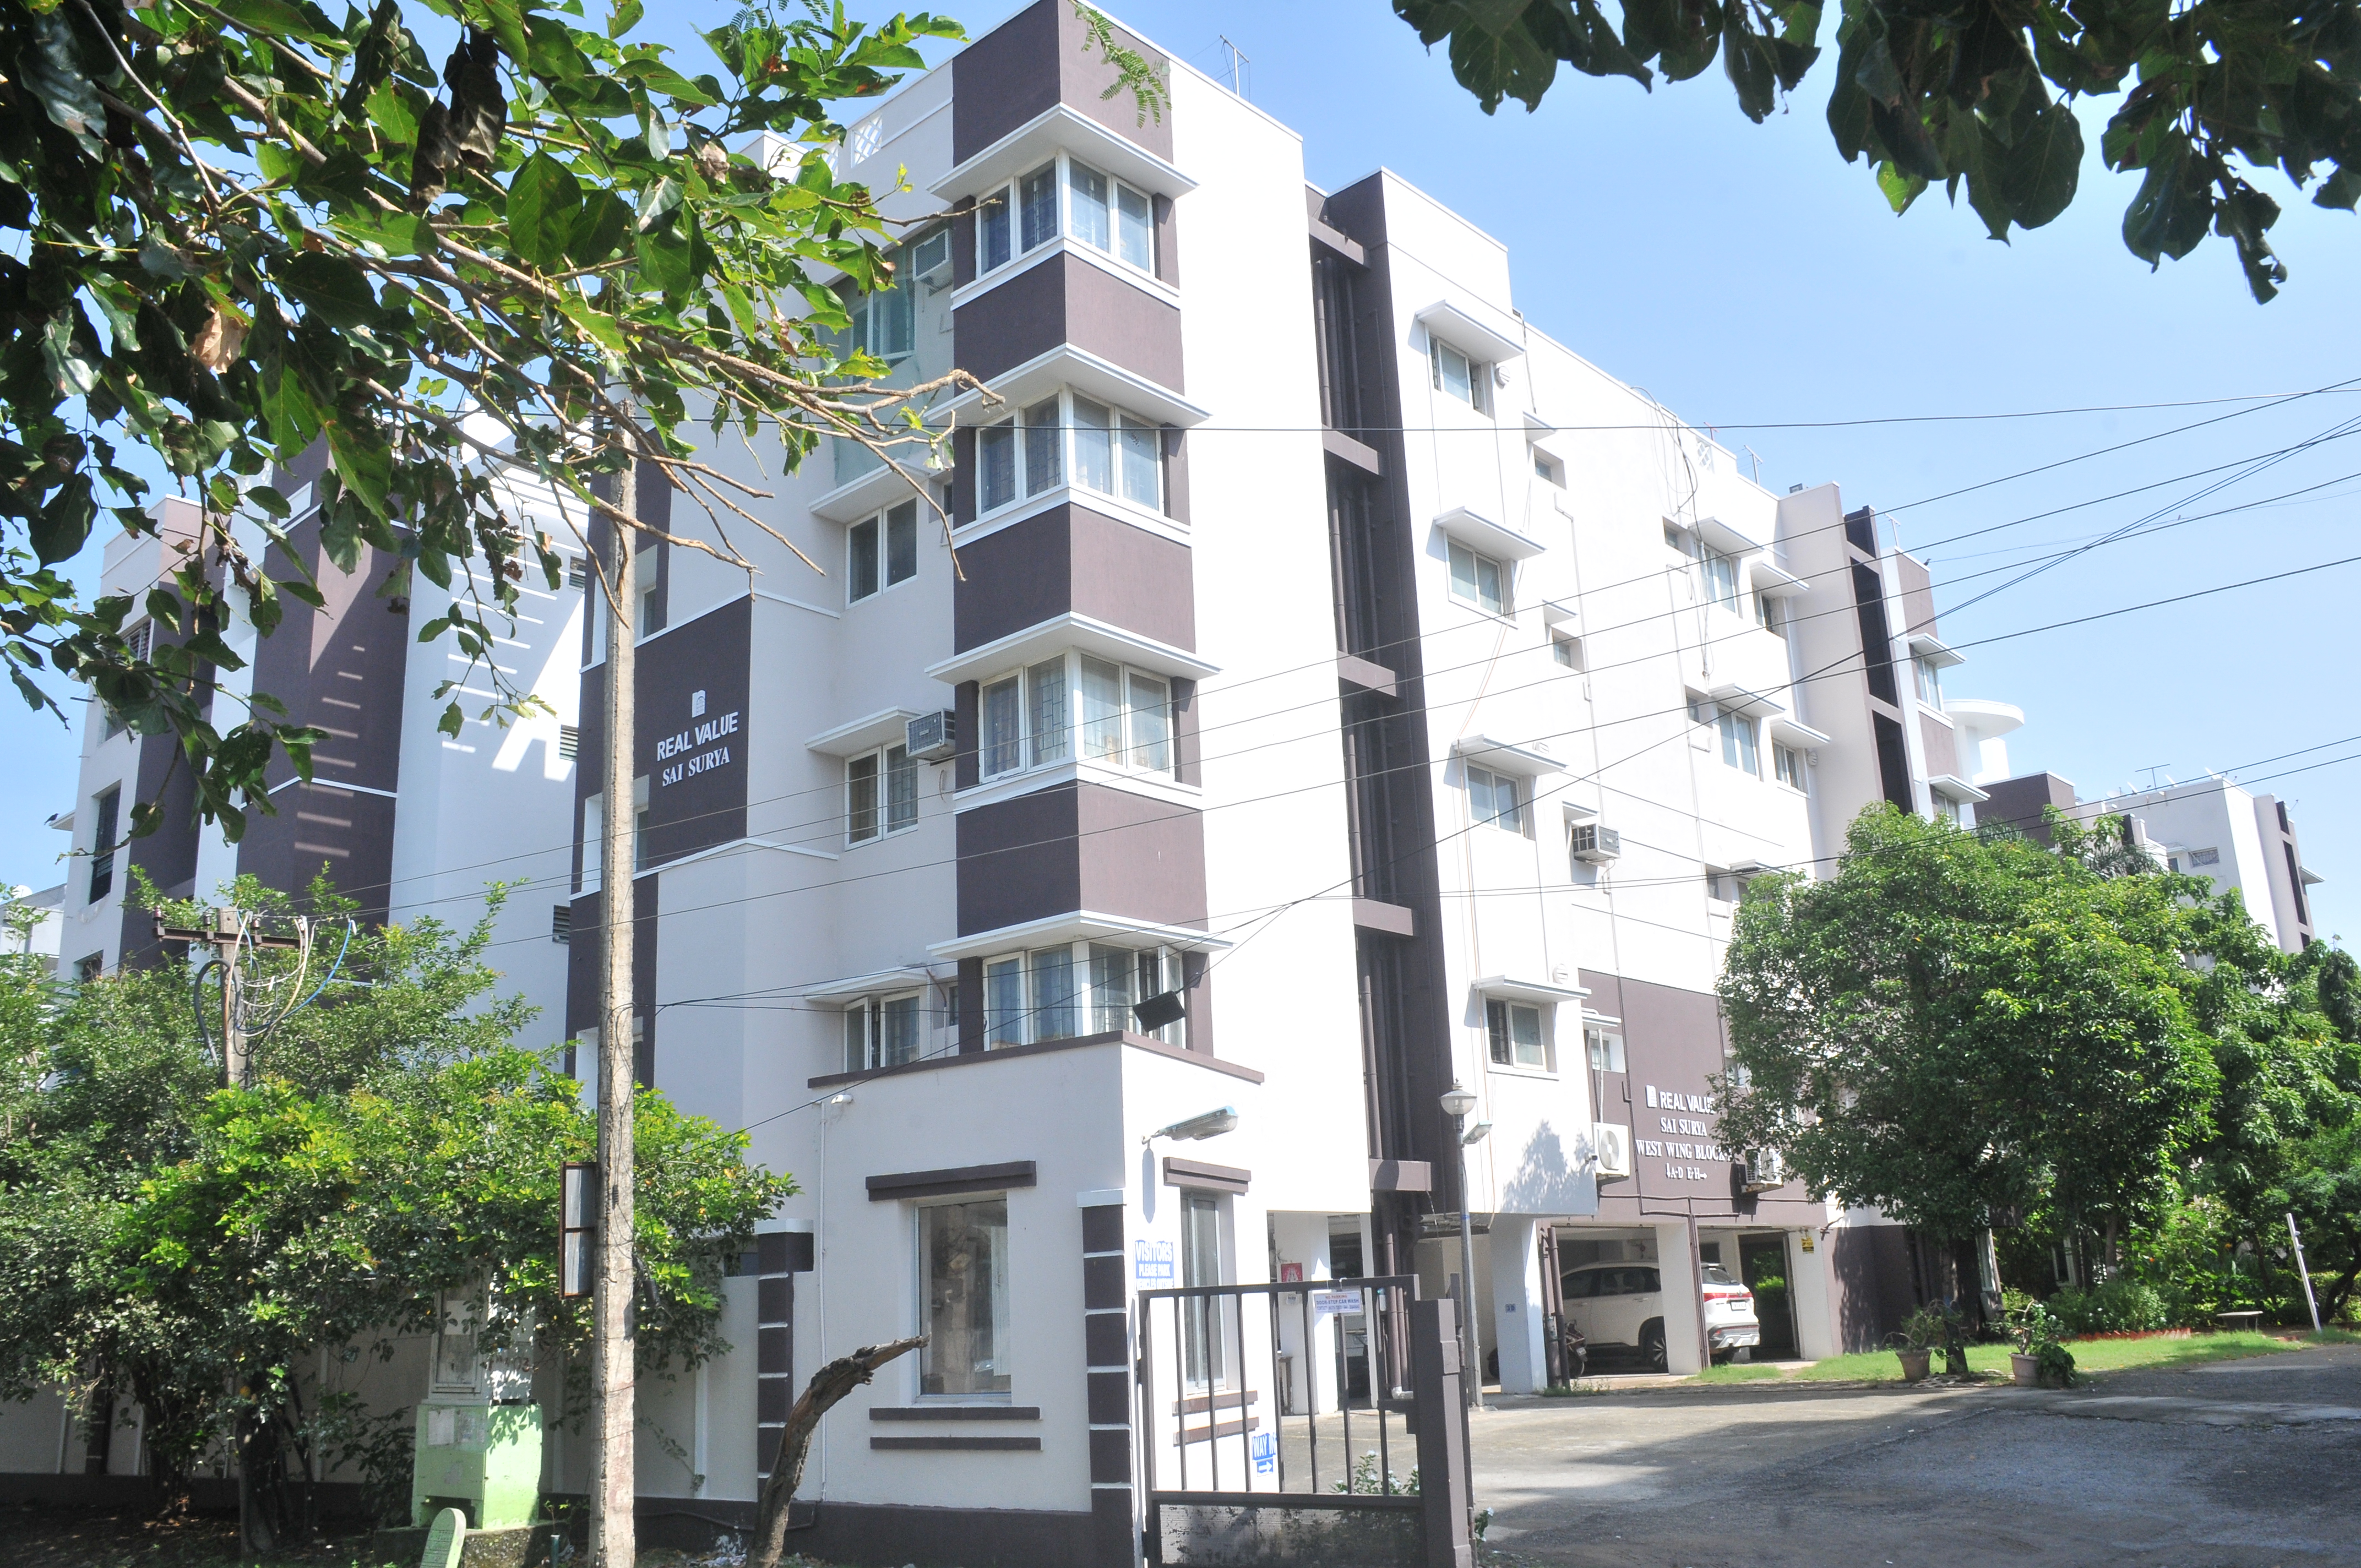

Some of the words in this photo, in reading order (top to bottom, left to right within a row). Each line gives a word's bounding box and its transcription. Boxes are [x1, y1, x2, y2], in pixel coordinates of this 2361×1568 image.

[657, 731, 693, 761] REAL
[695, 711, 738, 745] VALUE
[662, 763, 683, 787] SAI
[688, 747, 730, 777] SURYA
[1660, 1091, 1686, 1111] REAL
[1661, 1117, 1677, 1133] SAI
[1679, 1119, 1707, 1136] SURYA
[1636, 1139, 1662, 1156] WEST
[1665, 1141, 1692, 1159] WING
[1135, 1241, 1173, 1262] VISITORS
[1139, 1263, 1157, 1277] PLEASE
[1157, 1264, 1171, 1277] PARK
[1253, 1436, 1267, 1457] WAY
